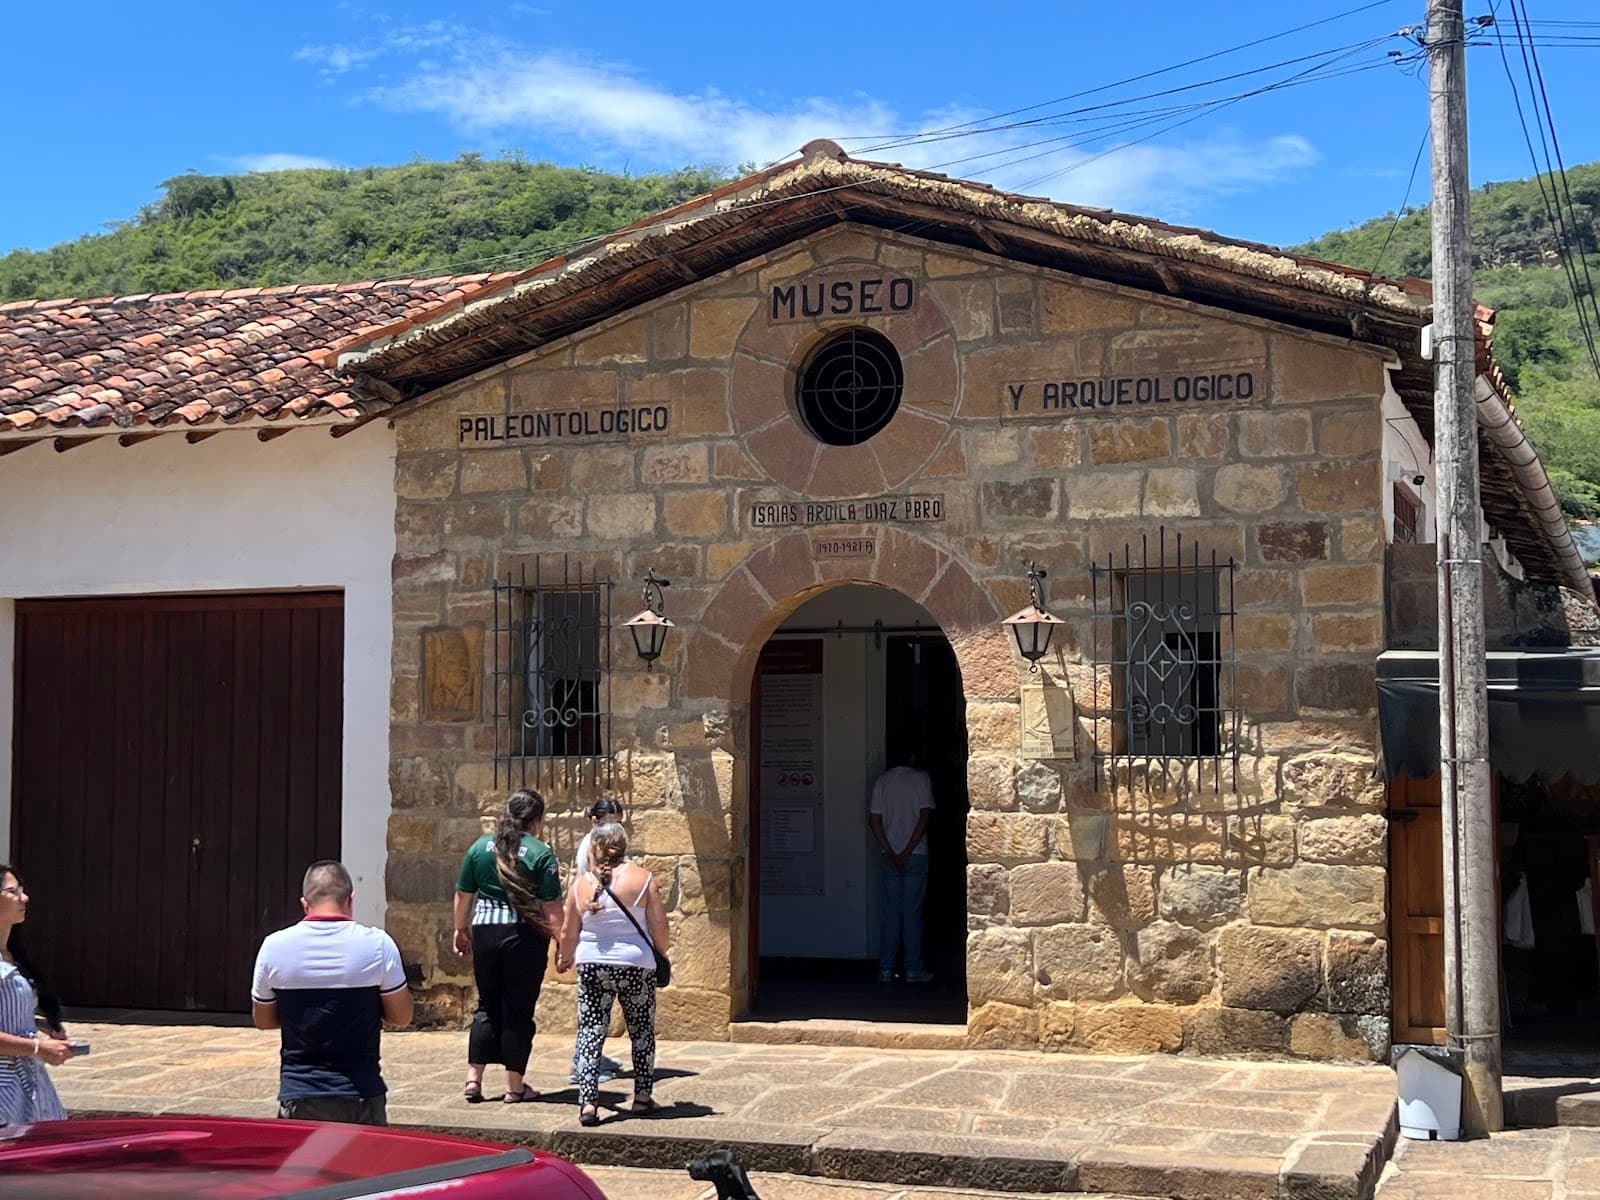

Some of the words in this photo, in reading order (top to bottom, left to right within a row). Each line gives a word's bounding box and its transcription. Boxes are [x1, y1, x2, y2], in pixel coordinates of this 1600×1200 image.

[772, 278, 913, 319] MUSEO
[1008, 384, 1025, 411] Y
[1043, 372, 1254, 409] ARQUEOLOGICO
[459, 406, 669, 442] PALEONTOLOGICO
[753, 504, 798, 524] ISAIAS
[806, 503, 857, 523] ARDILA
[865, 500, 898, 521] DIAZ
[905, 499, 941, 519] PBRO
